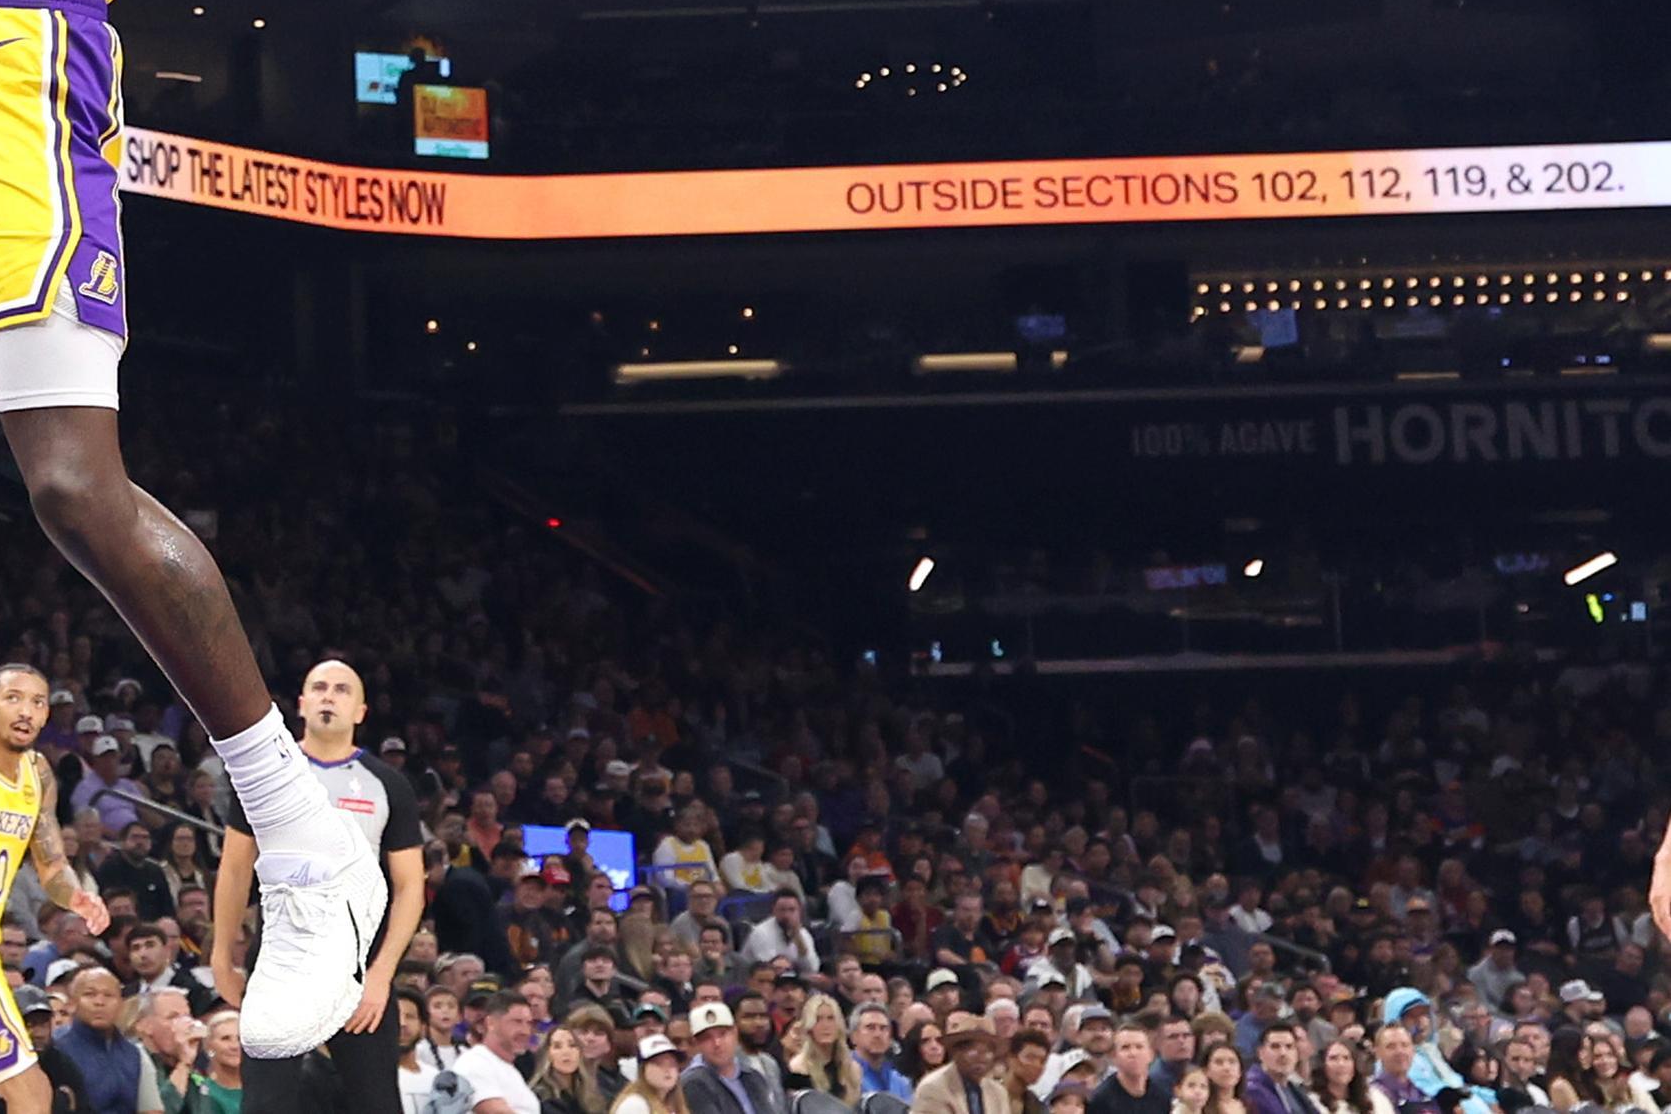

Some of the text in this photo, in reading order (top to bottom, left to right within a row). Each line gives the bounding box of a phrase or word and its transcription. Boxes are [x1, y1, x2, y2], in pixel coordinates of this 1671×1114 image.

[128, 137, 446, 224] SHOP THE LATEST STYLES NOW
[846, 160, 1626, 214] OUTSIDE SECTIONS 102, 112, 119, & 202.
[1219, 420, 1317, 455] AGAVE
